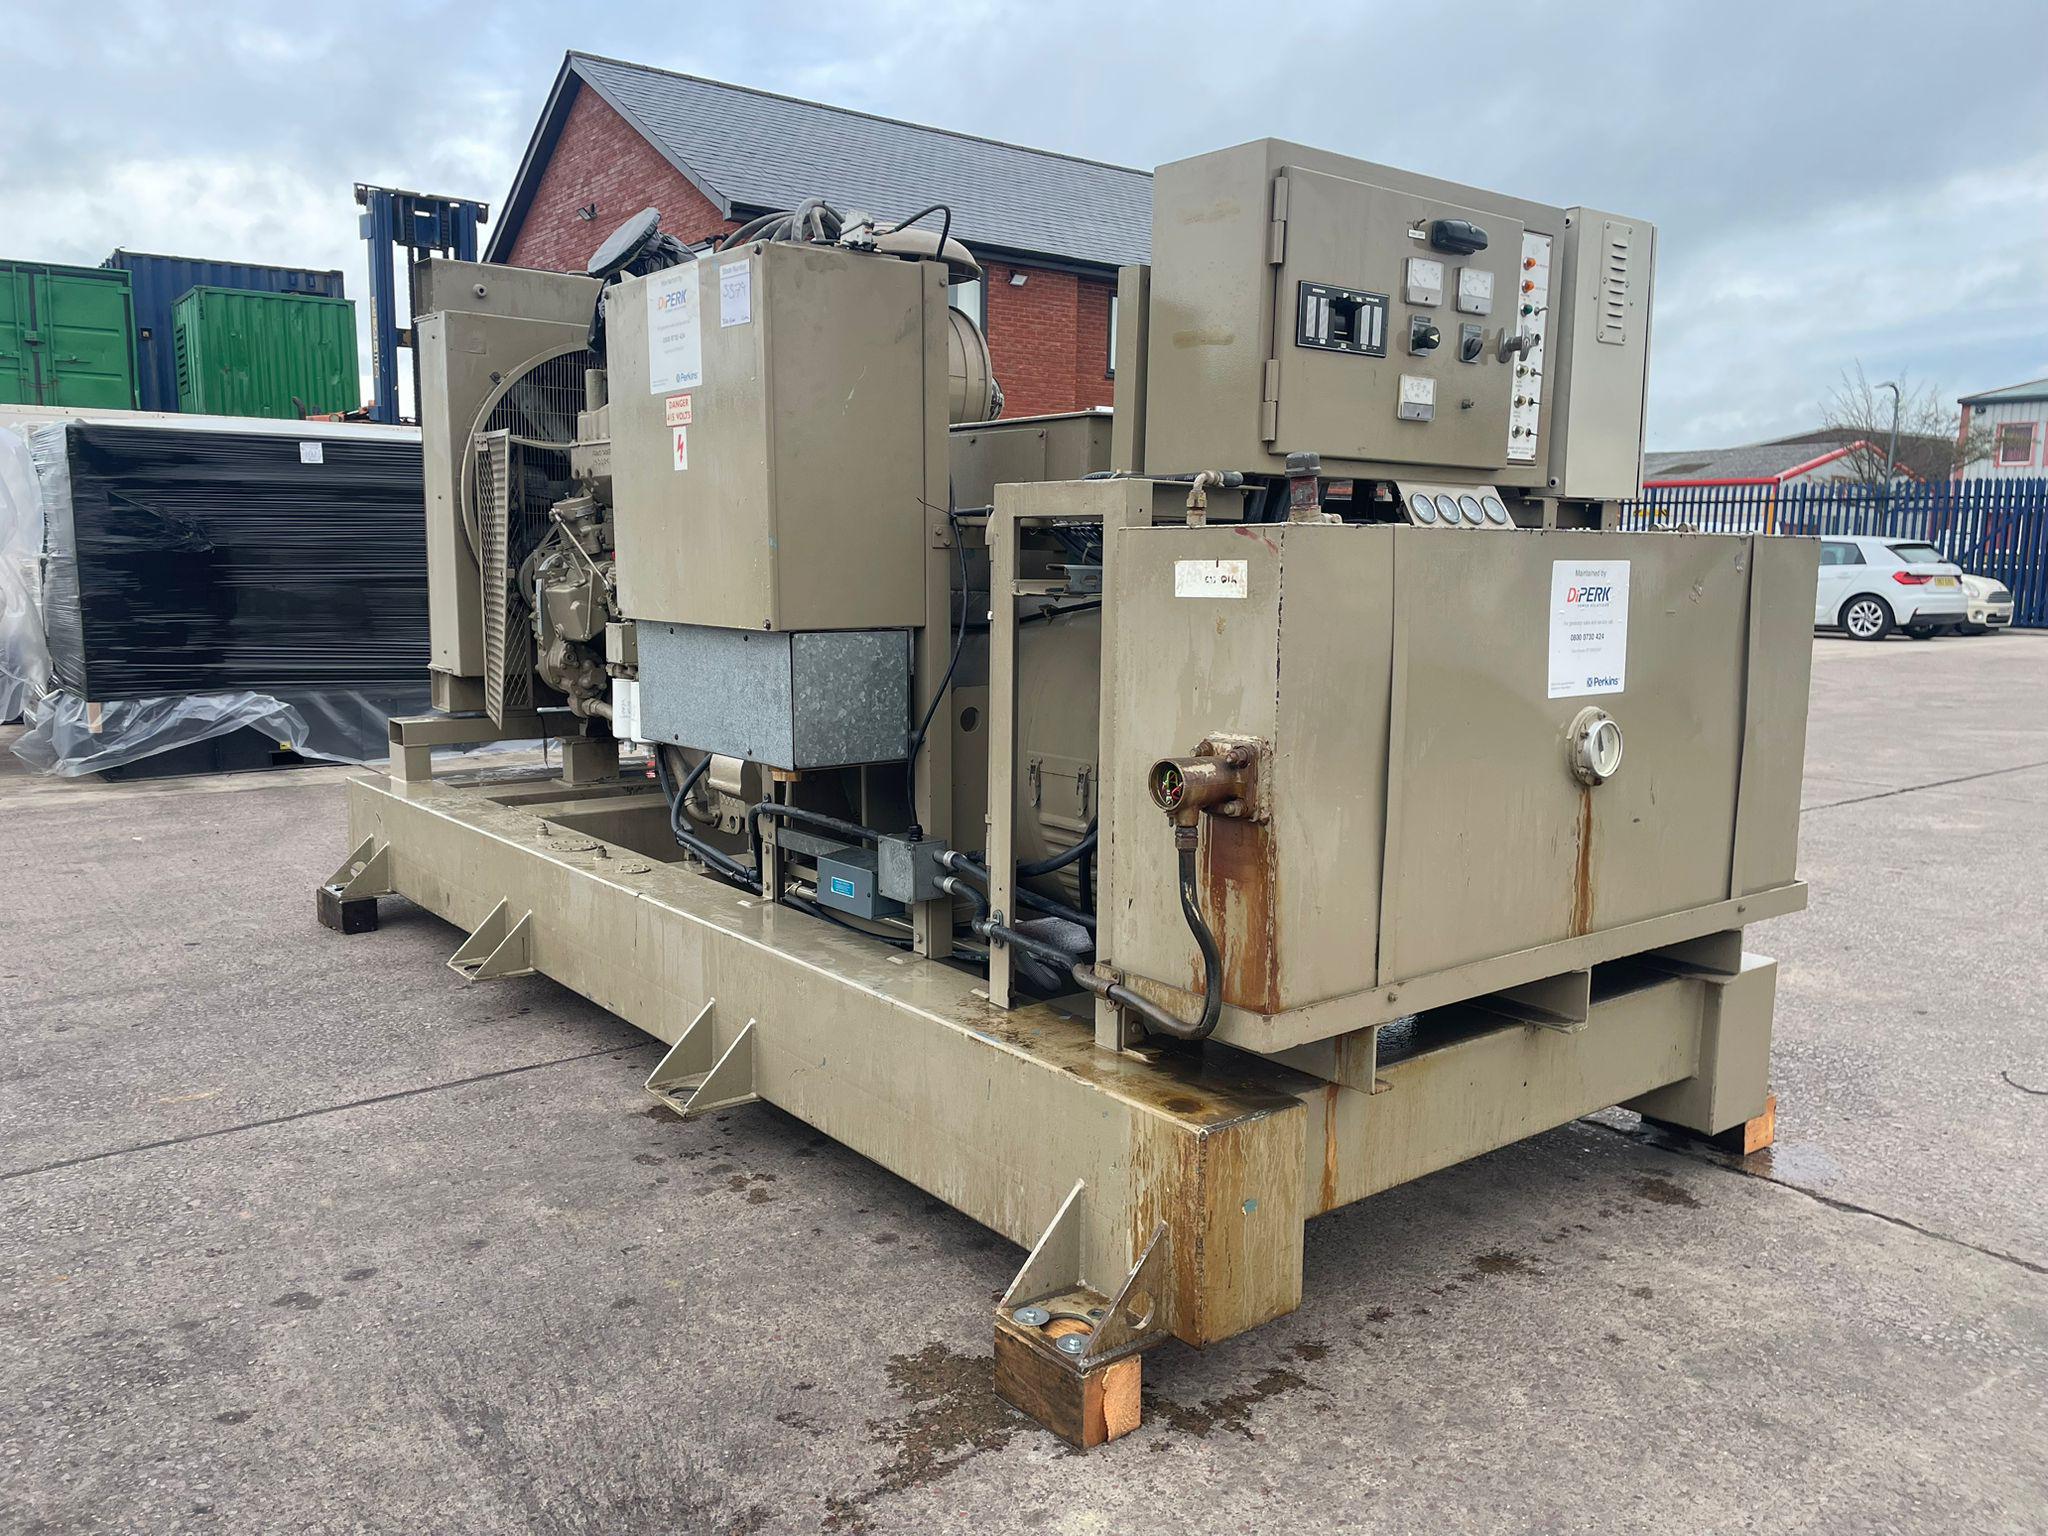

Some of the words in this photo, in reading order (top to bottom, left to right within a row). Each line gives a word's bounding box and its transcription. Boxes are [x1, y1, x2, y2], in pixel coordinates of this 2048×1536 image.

[668, 398, 689, 409] DANGER
[676, 411, 691, 420] VOLTS
[1567, 586, 1611, 602] DiPERK
[1593, 676, 1618, 686] Perkins
